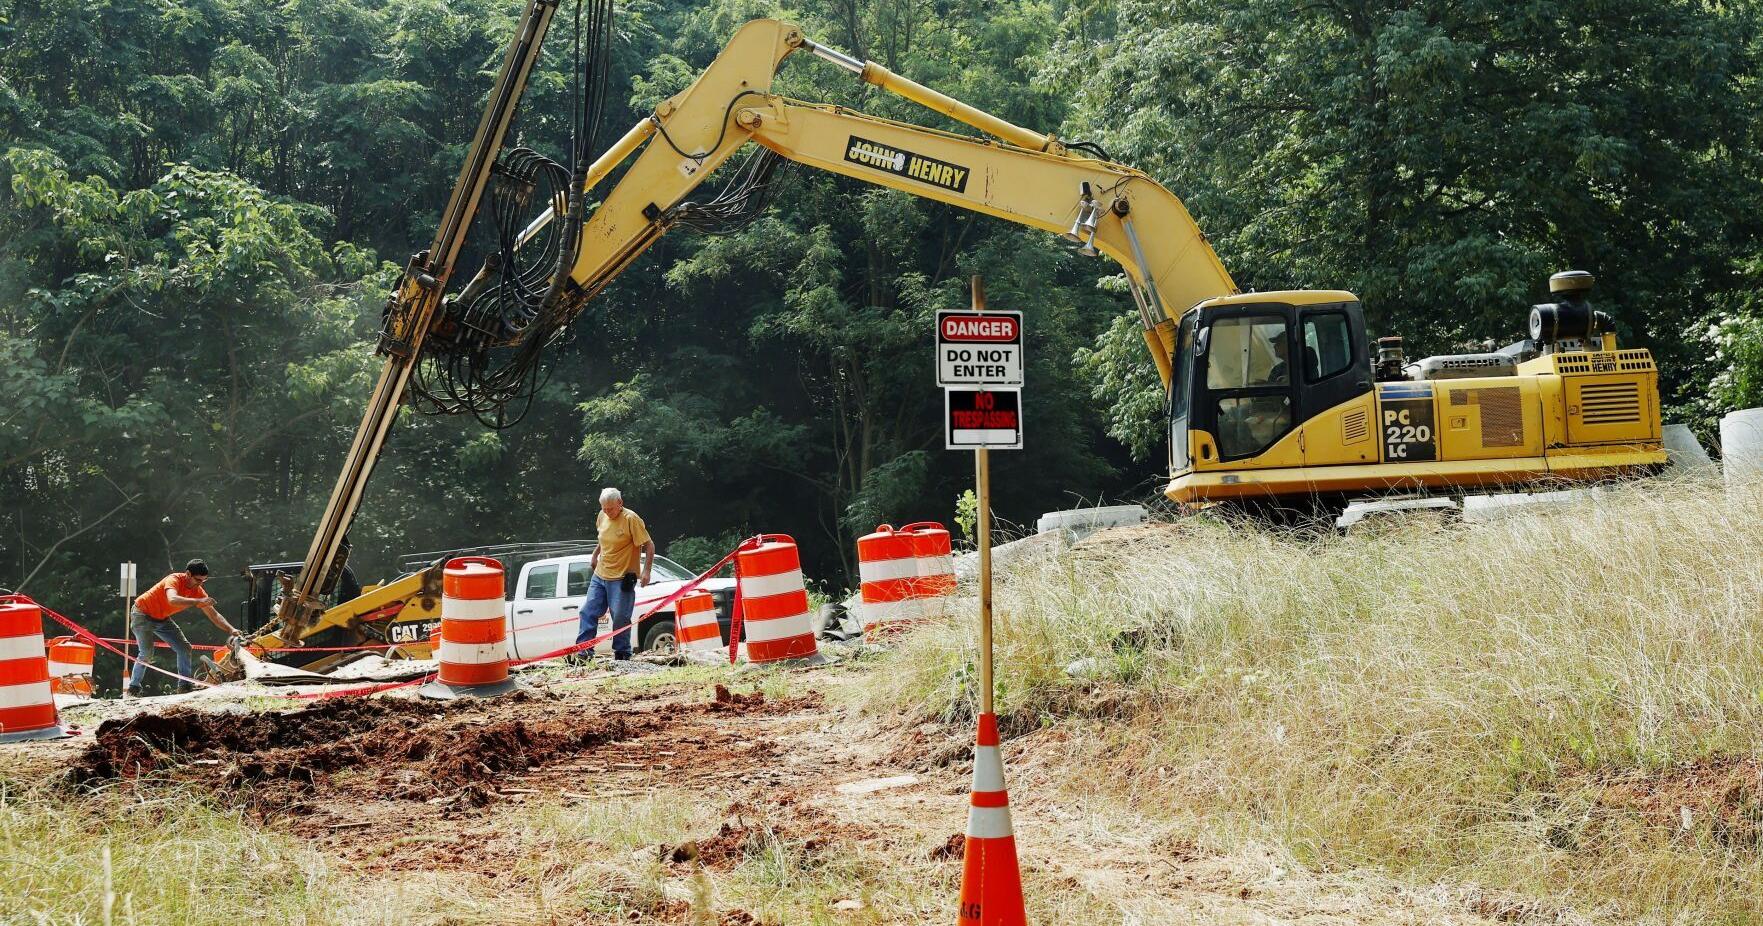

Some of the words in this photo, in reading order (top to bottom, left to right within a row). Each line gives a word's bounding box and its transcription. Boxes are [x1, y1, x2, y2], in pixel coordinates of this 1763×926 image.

[907, 156, 965, 189] HENRY
[946, 321, 1013, 336] DANGER
[947, 350, 972, 363] DO
[977, 350, 1012, 363] NOT
[953, 365, 1006, 377] ENTER
[1592, 362, 1617, 373] HENRY
[975, 391, 994, 410] NO
[951, 410, 1017, 429] TRESPASSING
[1384, 409, 1410, 426] PC
[1386, 425, 1431, 444] 220
[1388, 443, 1407, 458] LC
[391, 624, 418, 642] CAT
